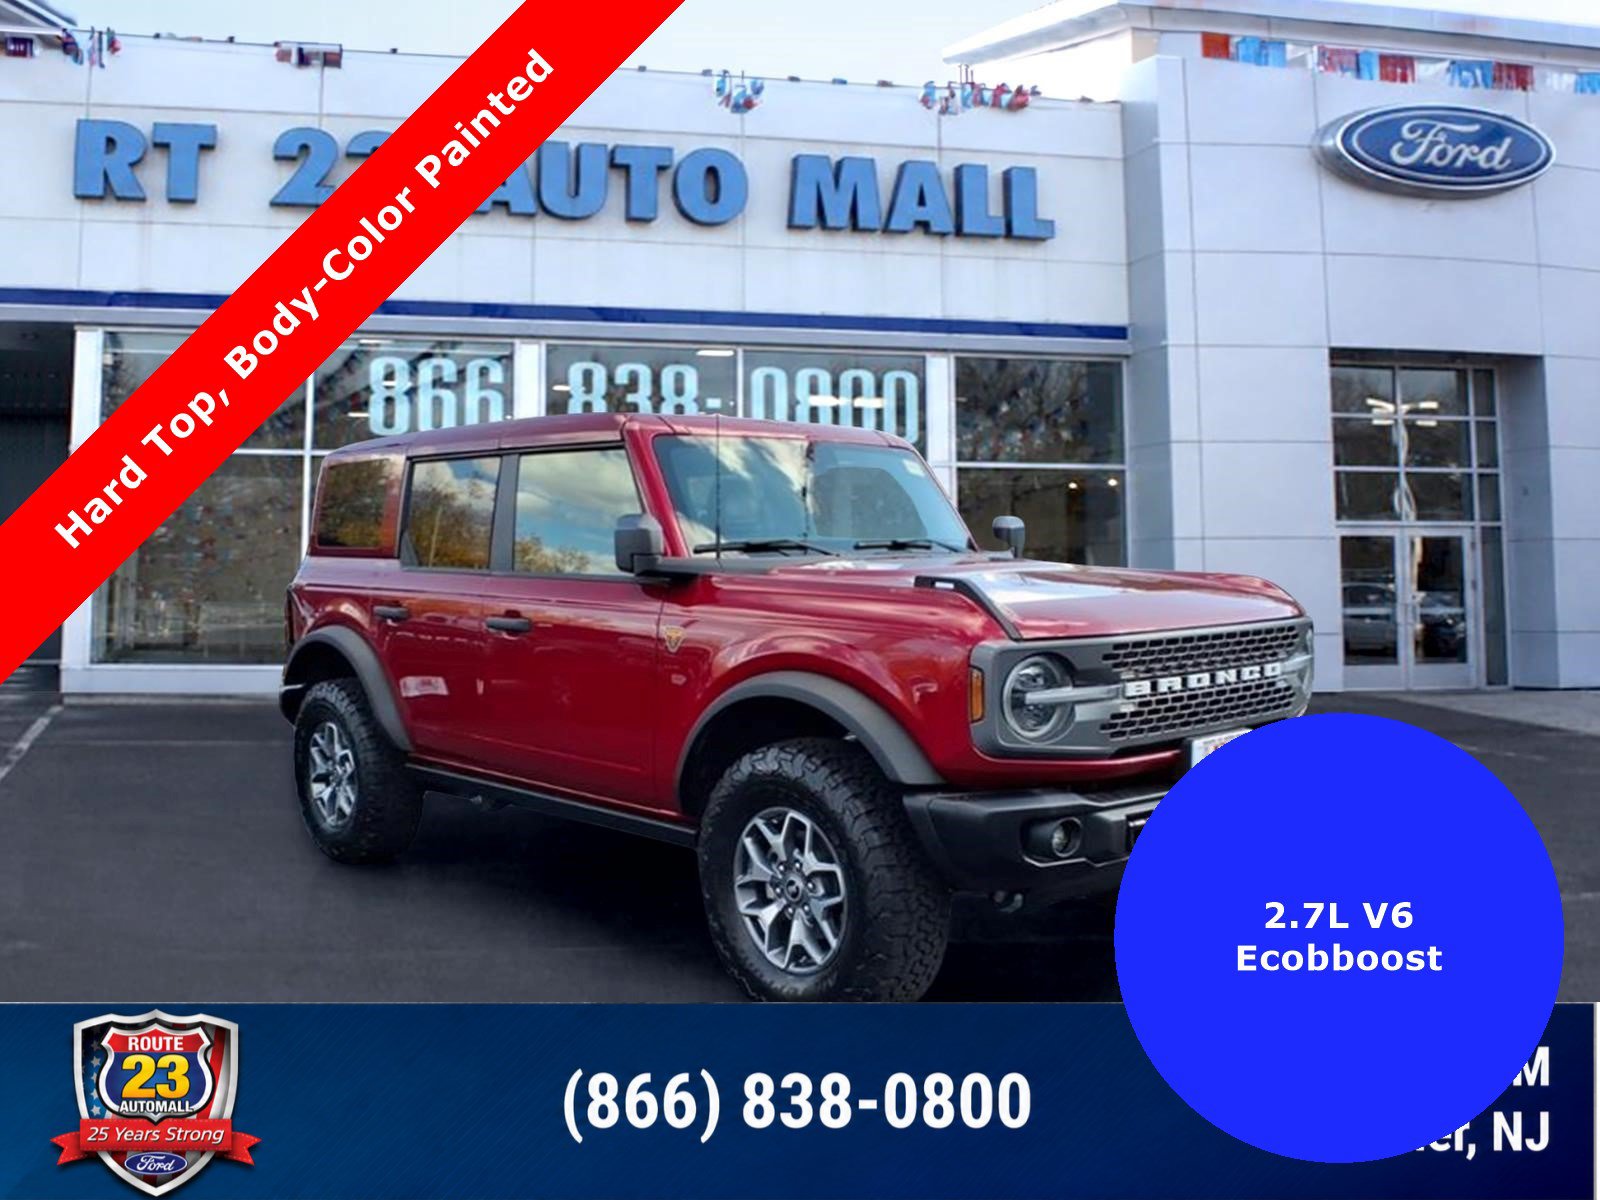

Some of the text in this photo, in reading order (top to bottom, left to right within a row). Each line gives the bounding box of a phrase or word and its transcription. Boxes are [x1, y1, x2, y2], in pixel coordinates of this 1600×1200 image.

[1389, 118, 1512, 170] Ford
[74, 118, 217, 204] RT
[269, 127, 394, 207] 2
[787, 153, 1055, 240] MALL
[369, 357, 504, 436] 866
[1124, 662, 1282, 698] BRONCO
